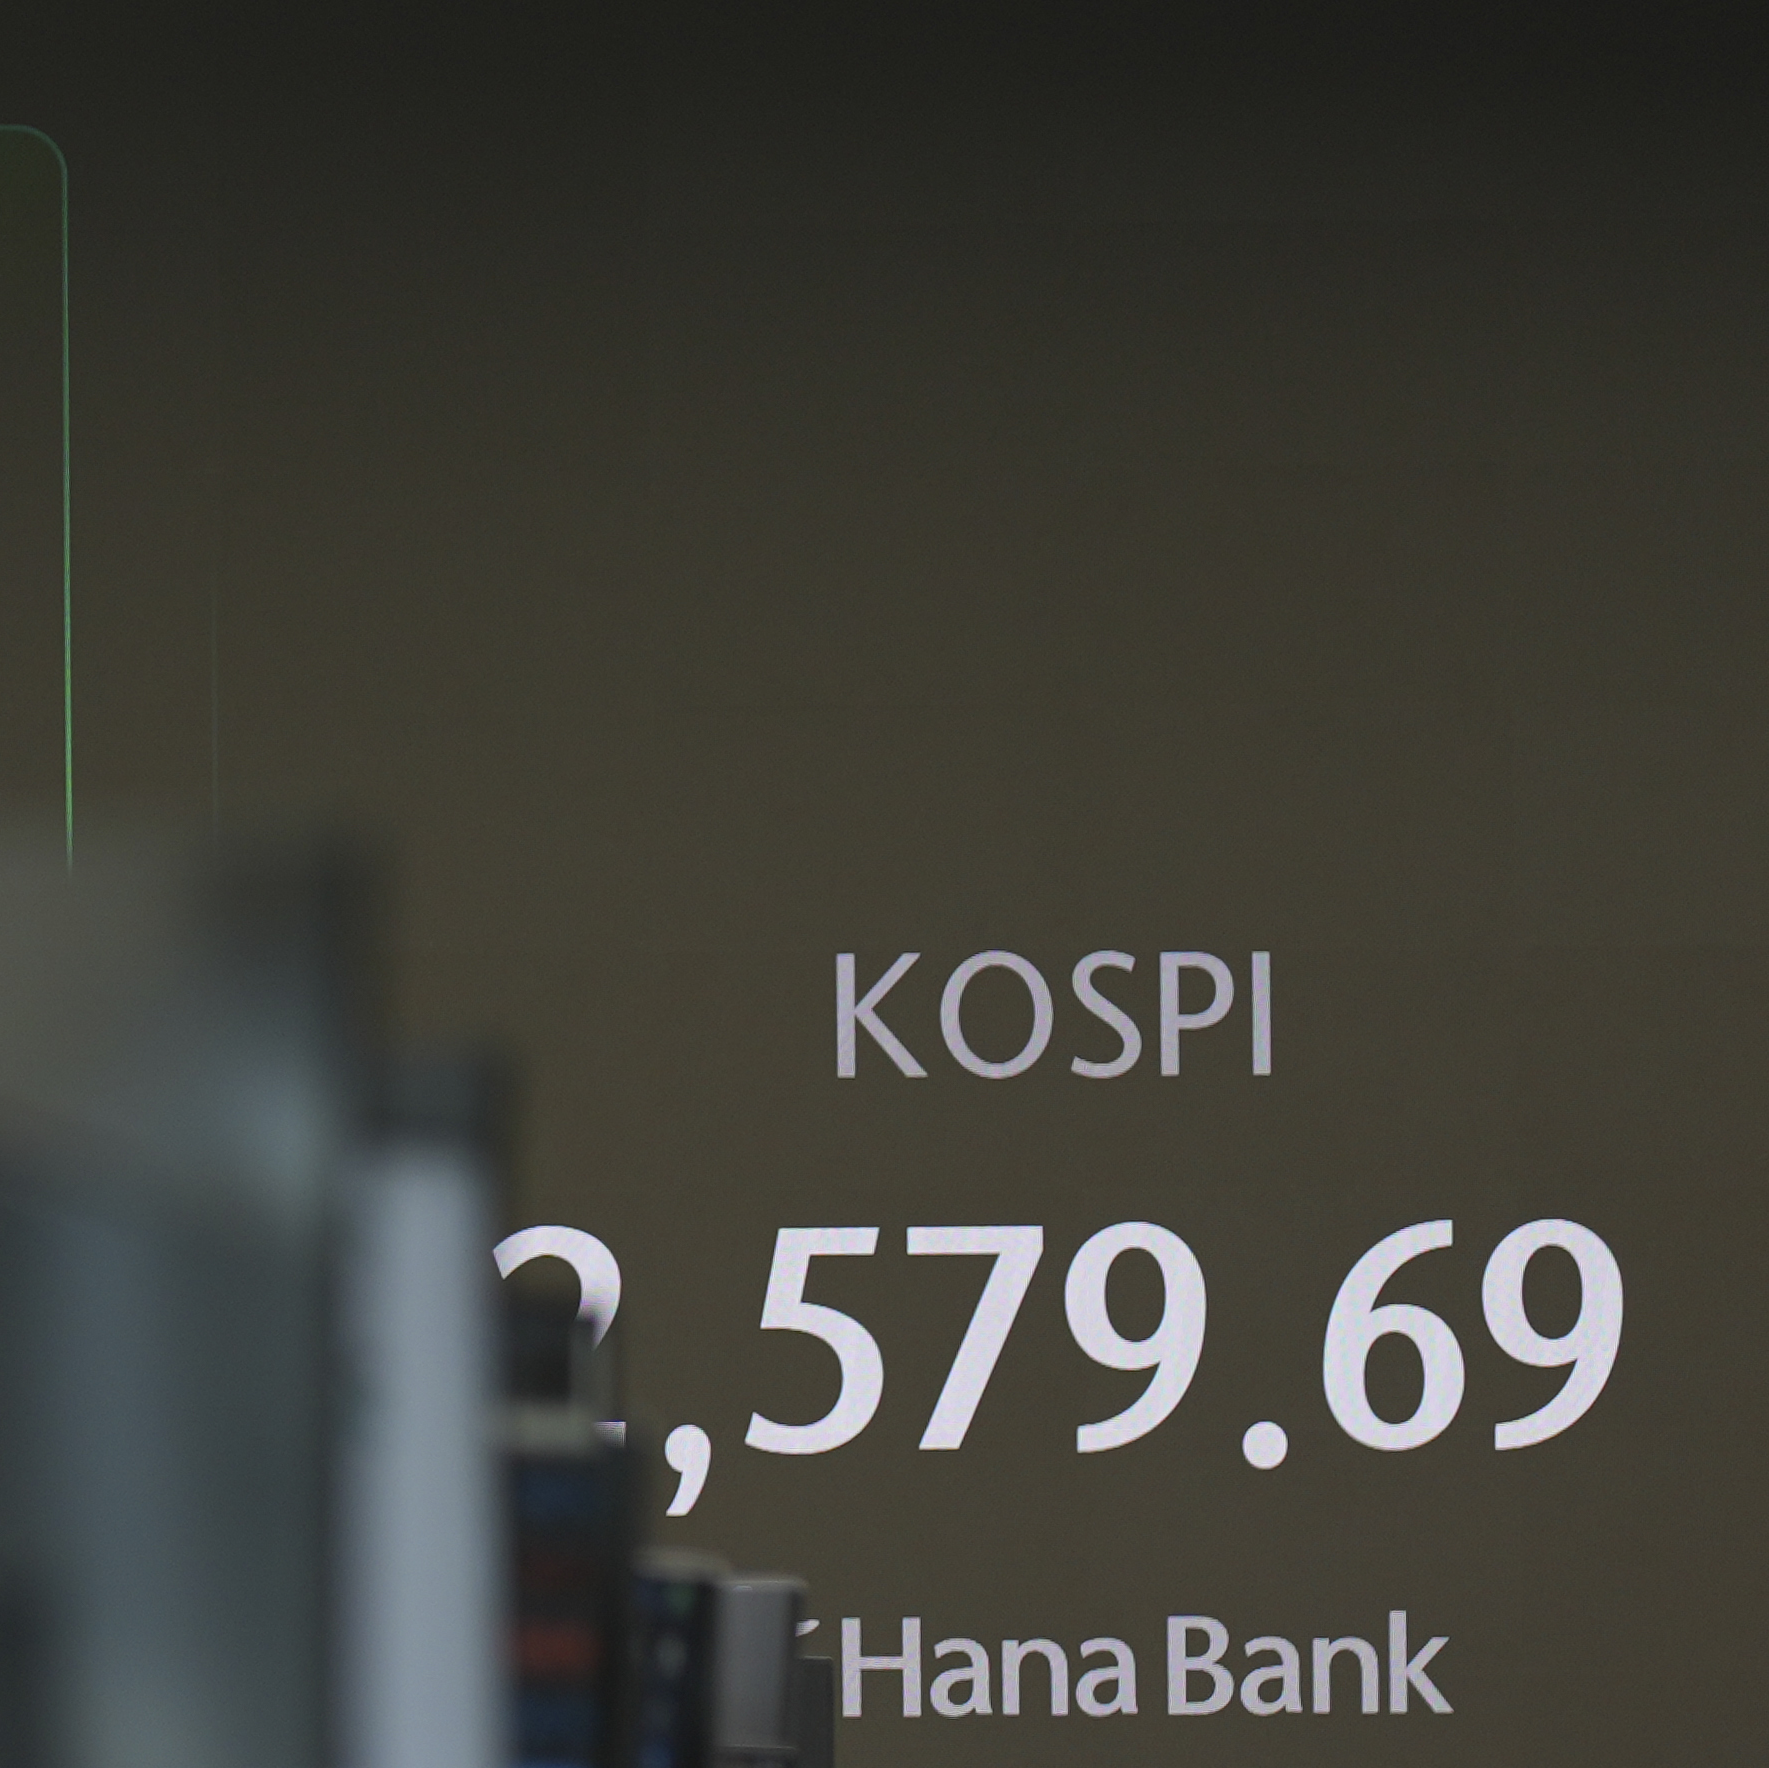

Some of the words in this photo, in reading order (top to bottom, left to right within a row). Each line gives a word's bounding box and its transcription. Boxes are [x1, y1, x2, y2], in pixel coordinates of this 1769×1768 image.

[835, 951, 1274, 1079] KOSPI
[841, 1616, 1138, 1719] Hana
[1167, 1608, 1454, 1716] Bank
